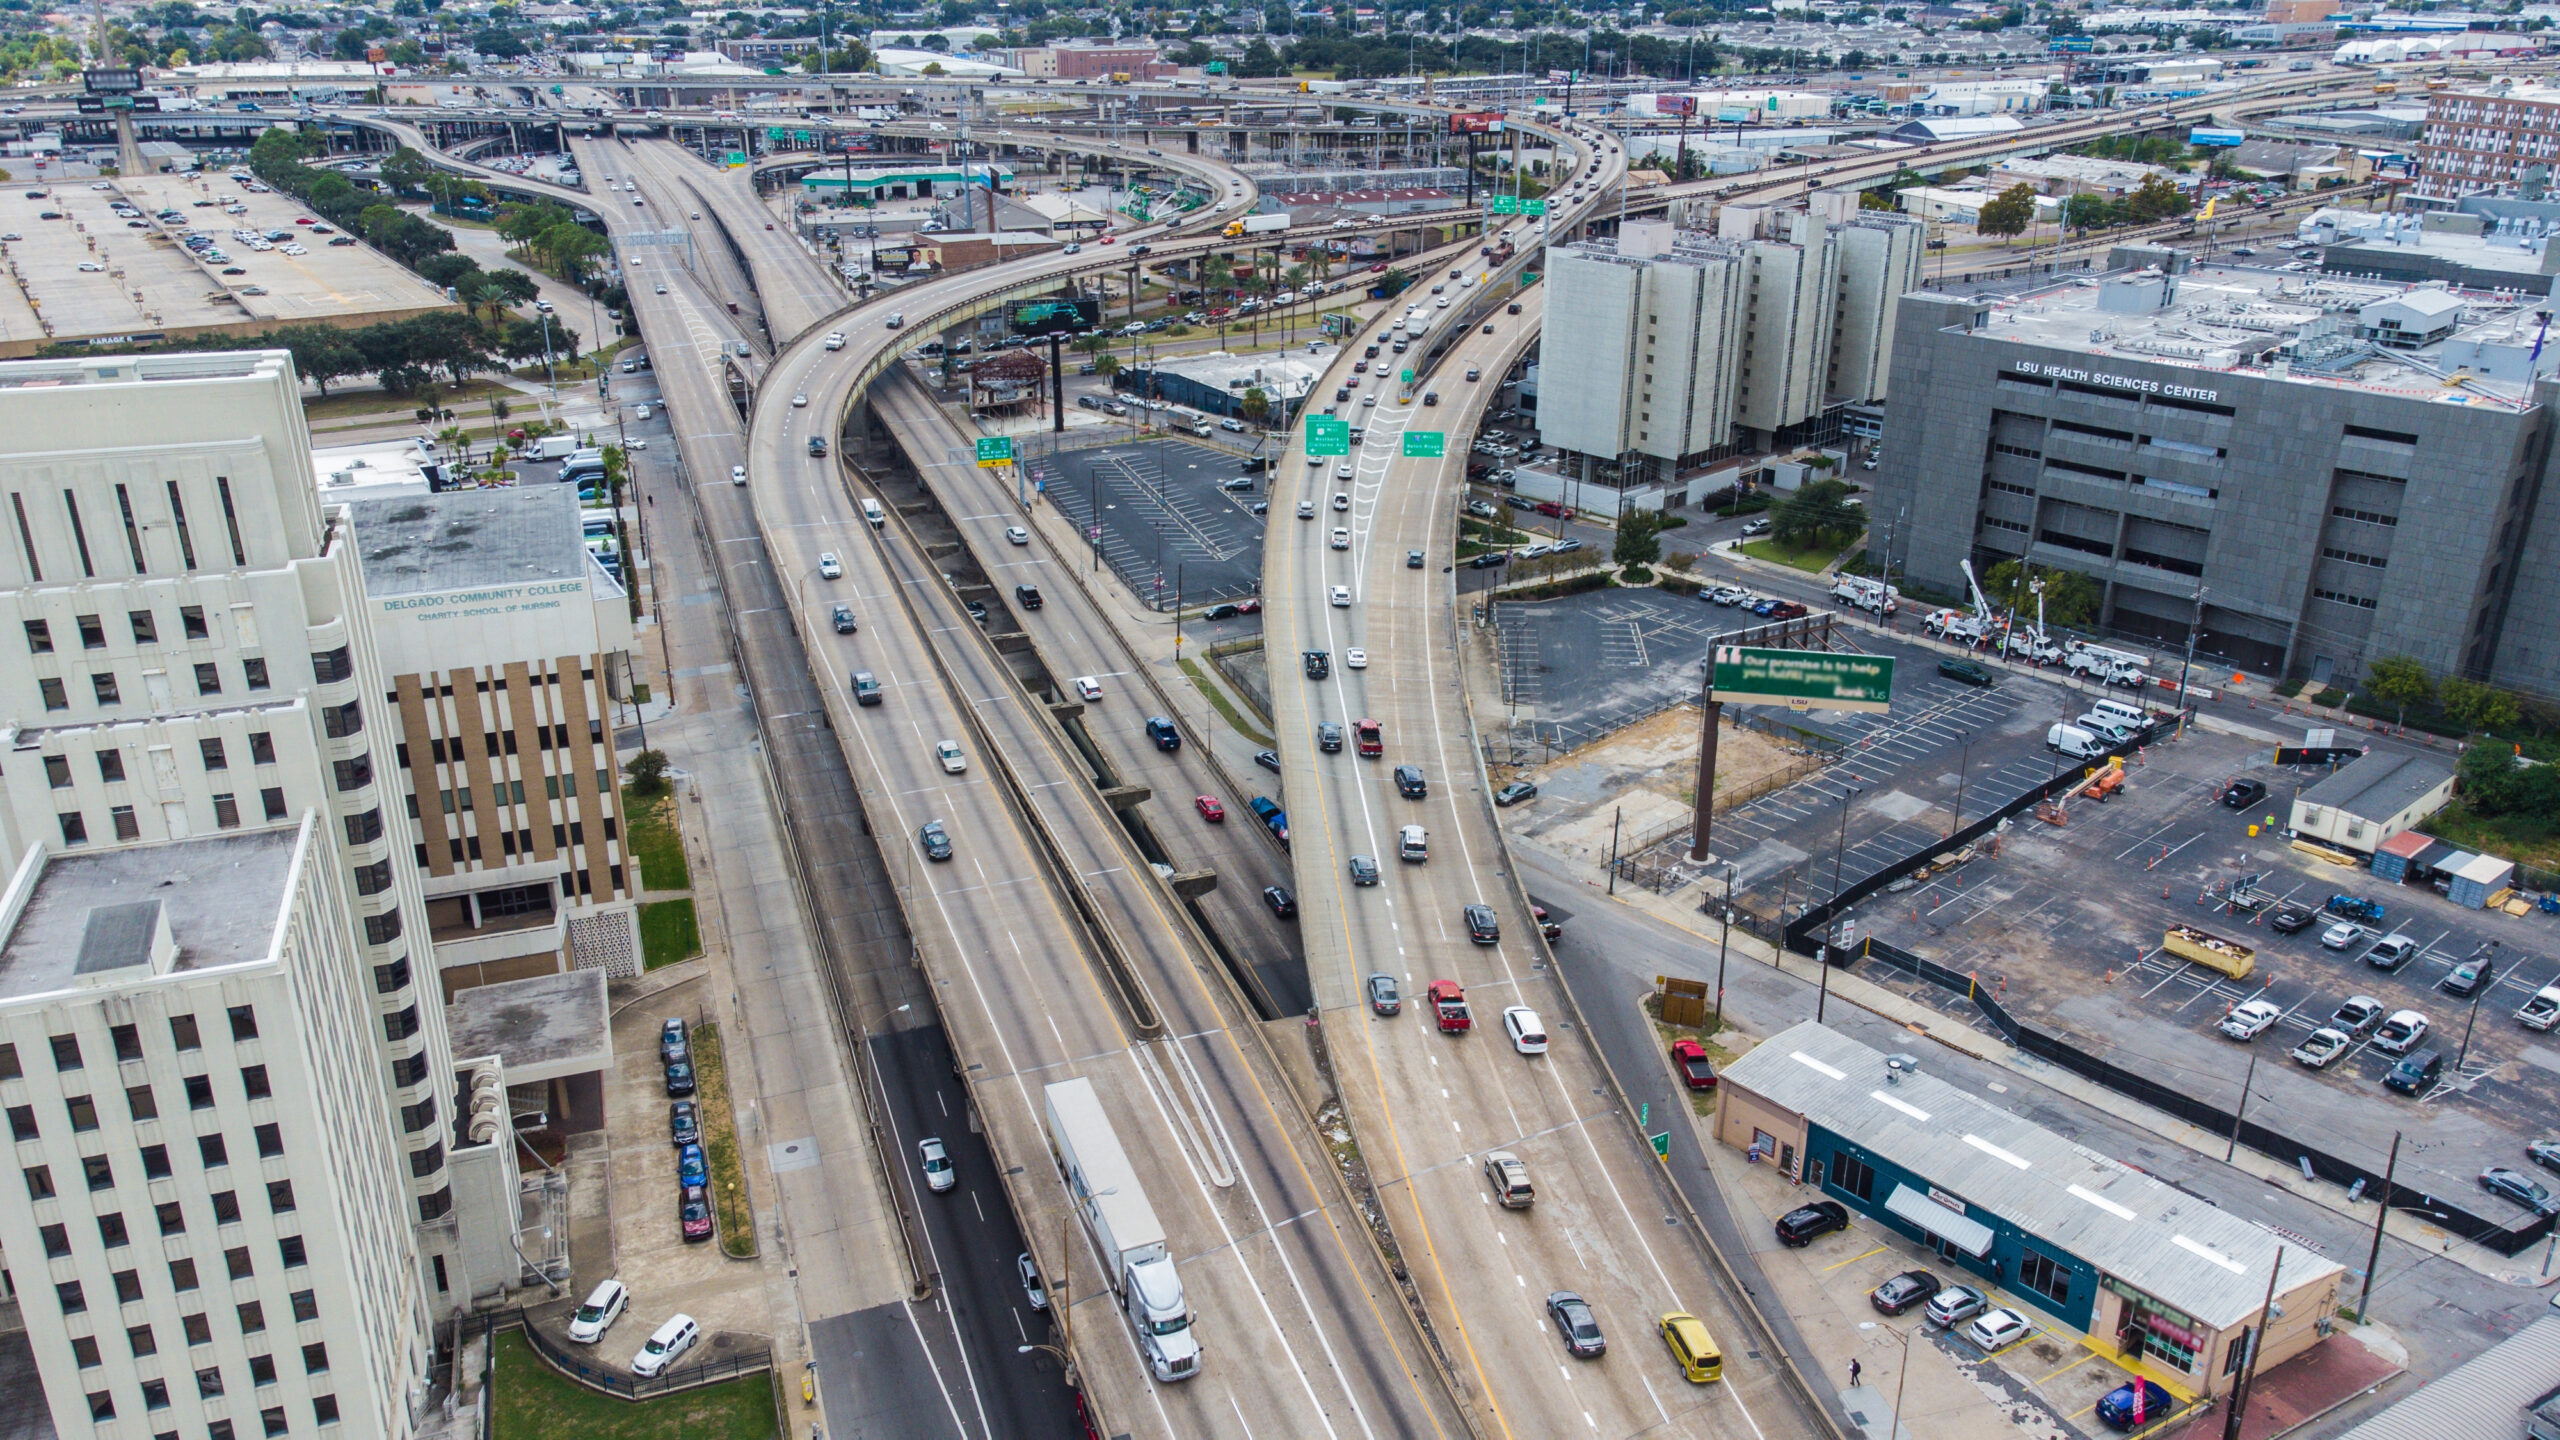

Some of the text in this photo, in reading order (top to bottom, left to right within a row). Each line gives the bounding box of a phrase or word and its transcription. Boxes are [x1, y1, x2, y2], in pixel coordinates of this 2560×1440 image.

[89, 336, 125, 345] GARAGE
[2015, 360, 2218, 401] LSU HEALTH SCIENCES CENTER
[384, 582, 584, 611] DELGADO COMMUNITY COLLEGE
[417, 600, 561, 622] CHARITY SCHOOL OF NURSING
